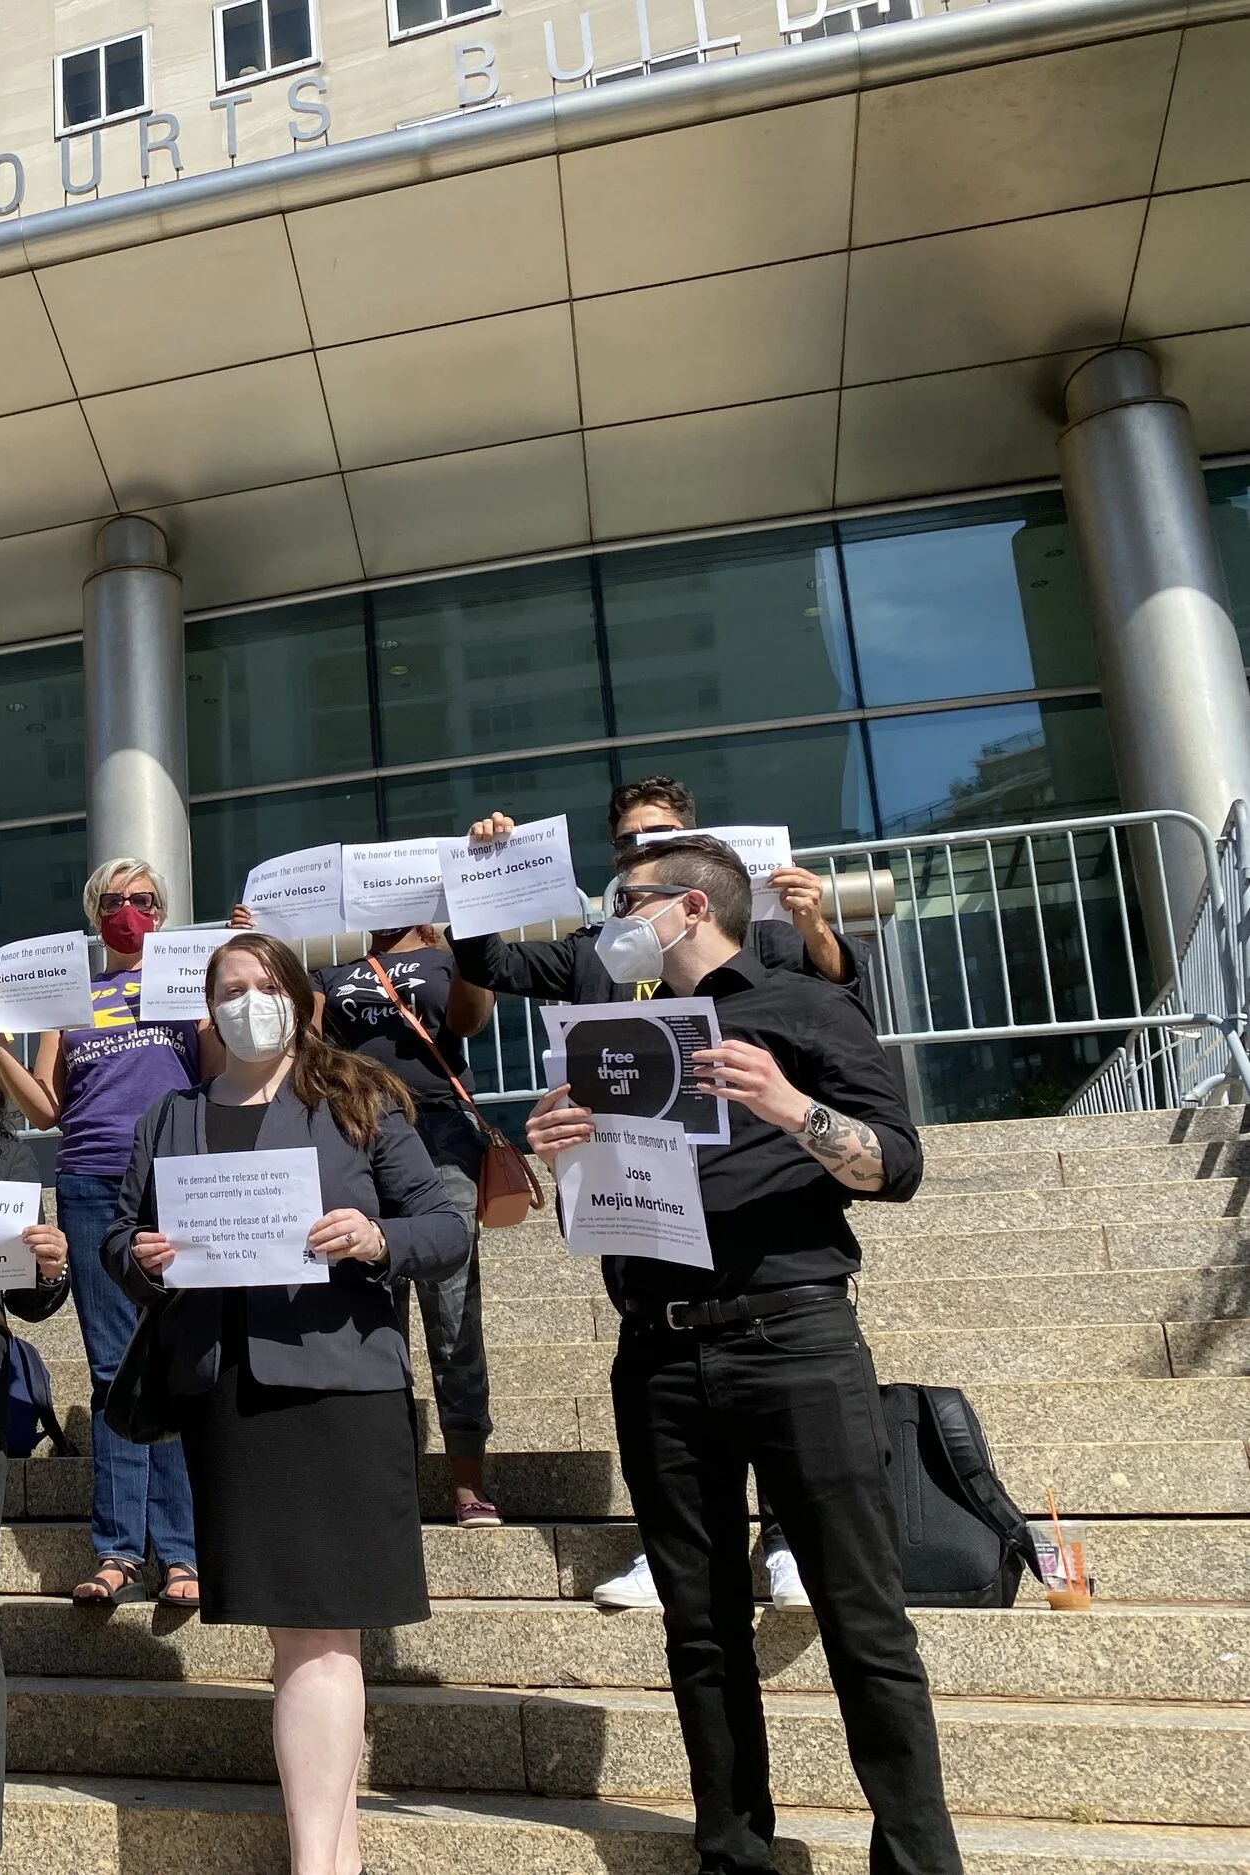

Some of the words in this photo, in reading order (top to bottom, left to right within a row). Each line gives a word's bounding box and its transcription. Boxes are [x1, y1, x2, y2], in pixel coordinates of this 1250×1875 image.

[450, 848, 465, 860] We
[467, 844, 492, 857] honor
[494, 840, 508, 852] the
[509, 832, 544, 848] memory
[546, 827, 555, 838] of
[765, 837, 775, 846] of
[354, 852, 366, 860] We
[368, 851, 392, 859] honor
[394, 849, 407, 858] the
[409, 848, 438, 856] memor
[260, 871, 278, 881] honor
[280, 867, 291, 877] the
[292, 863, 322, 874] memory
[323, 859, 332, 869] of
[461, 867, 502, 884] Robert
[504, 855, 553, 874] Jackson
[363, 878, 392, 889] Esias
[251, 890, 282, 902] Javier
[284, 885, 326, 896] Velasco
[0, 951, 20, 962] honor
[21, 948, 33, 958] the
[34, 945, 64, 956] memory
[66, 941, 74, 952] of
[154, 945, 166, 955] We
[168, 944, 191, 954] honor
[193, 944, 206, 953] the
[37, 967, 67, 978] Blake
[167, 985, 206, 994] Brauns
[82, 1034, 124, 1051] York's
[127, 1025, 173, 1040] Health
[177, 1032, 184, 1042] &
[104, 1037, 150, 1056] Service
[153, 1035, 186, 1055] Union
[601, 1048, 634, 1064] free
[597, 1064, 640, 1080] them
[610, 1079, 630, 1096] all
[594, 1130, 621, 1143] honor
[623, 1130, 637, 1145] the
[638, 1134, 668, 1152] memory
[669, 1137, 678, 1151] of
[177, 1176, 188, 1185] We
[189, 1174, 217, 1185] demand
[218, 1174, 230, 1183] the
[232, 1172, 259, 1182] release
[260, 1171, 268, 1180] of
[270, 1171, 290, 1181] every
[625, 1167, 652, 1182] Jose
[185, 1191, 208, 1202] person
[209, 1188, 243, 1199] currently
[244, 1188, 251, 1197] in
[13, 1201, 25, 1214] of
[591, 1193, 633, 1211] Mejia
[634, 1195, 685, 1216] Martinez
[177, 1219, 188, 1229] We
[190, 1218, 218, 1228] demand
[219, 1217, 232, 1226] the
[233, 1216, 260, 1226] release
[261, 1214, 270, 1224] of
[271, 1214, 280, 1224] all
[282, 1213, 298, 1223] who
[191, 1234, 211, 1243] come
[212, 1233, 236, 1242] before
[237, 1231, 250, 1240] the
[251, 1230, 275, 1240] courts
[276, 1229, 284, 1239] of
[206, 1250, 222, 1260] New
[223, 1250, 240, 1259] York
